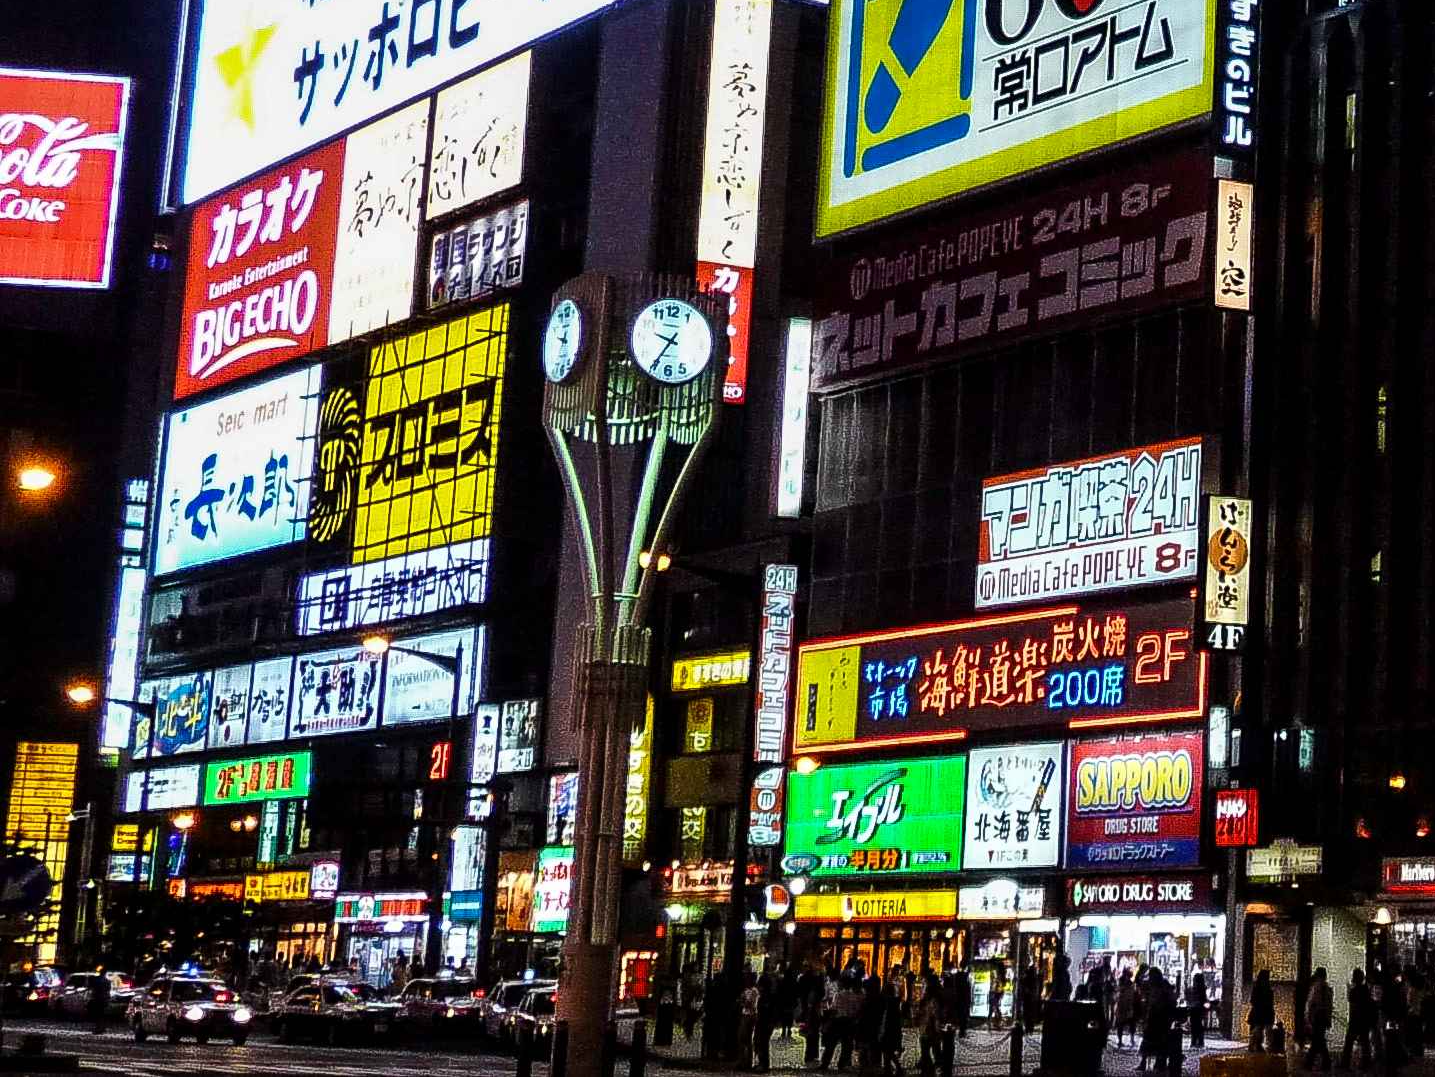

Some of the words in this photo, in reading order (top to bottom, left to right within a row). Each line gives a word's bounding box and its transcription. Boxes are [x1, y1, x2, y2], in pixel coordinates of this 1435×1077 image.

[993, 0, 1174, 120] 常口アトム
[0, 117, 88, 188] ola
[0, 189, 66, 222] Coke
[207, 168, 324, 269] カラオケ
[1031, 191, 1108, 244] 24H
[1120, 183, 1172, 216] 8F
[208, 275, 243, 301] Karaoke
[244, 245, 310, 286] Entertainment
[872, 254, 915, 290] Media
[918, 239, 955, 277] Cafe
[958, 216, 1023, 267] POPEYE
[666, 305, 681, 318] 12
[184, 451, 296, 542] 長次郎
[767, 568, 795, 591] 24H
[999, 566, 1040, 600] Media
[1043, 562, 1079, 593] Cafe
[1082, 546, 1147, 588] POPEYE
[1154, 541, 1197, 573] 8F
[1051, 615, 1127, 663] 炭火焼
[1134, 630, 1190, 684] 2F
[1207, 625, 1244, 650] 4F
[869, 684, 908, 721] 市場
[918, 637, 1048, 717] 海鮮道楽
[1048, 665, 1124, 709] 200席
[1078, 753, 1190, 808] SAPPORO
[826, 783, 905, 845] エイブル
[974, 808, 1052, 843] 北海番屋
[1104, 818, 1128, 835] DRUG
[1130, 816, 1159, 833] STORE
[855, 897, 908, 916] LOTTERIA
[1082, 882, 1120, 903] SAORO
[1122, 883, 1154, 902] DRUG
[1157, 882, 1194, 902] STORE
